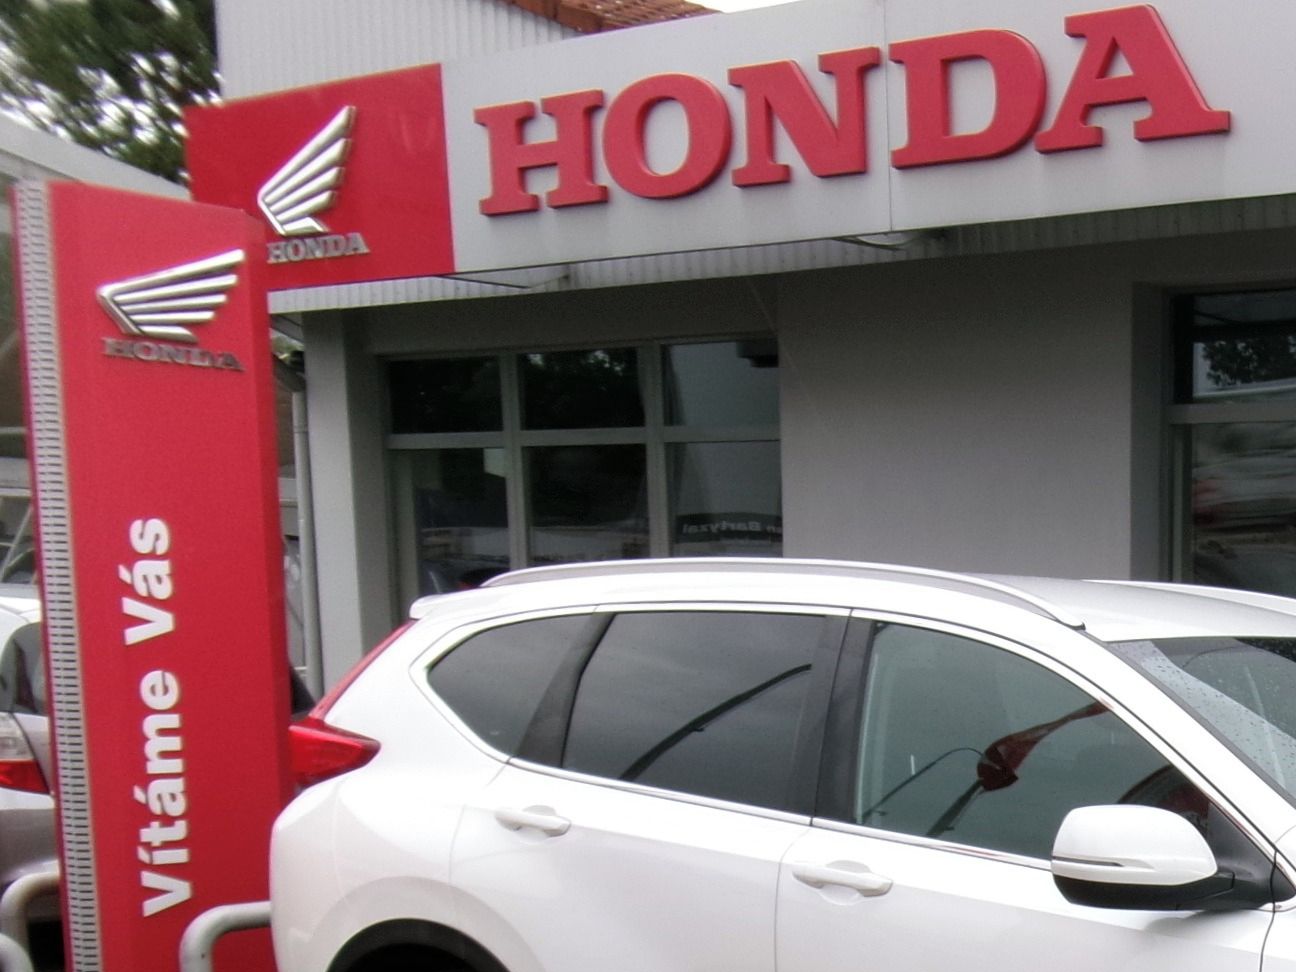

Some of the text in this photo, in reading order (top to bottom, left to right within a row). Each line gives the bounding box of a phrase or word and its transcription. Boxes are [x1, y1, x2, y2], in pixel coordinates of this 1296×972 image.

[474, 4, 1231, 217] HONDA
[267, 232, 371, 264] HONDA
[102, 337, 246, 371] HONDA
[118, 517, 194, 917] Vítáme Vás
